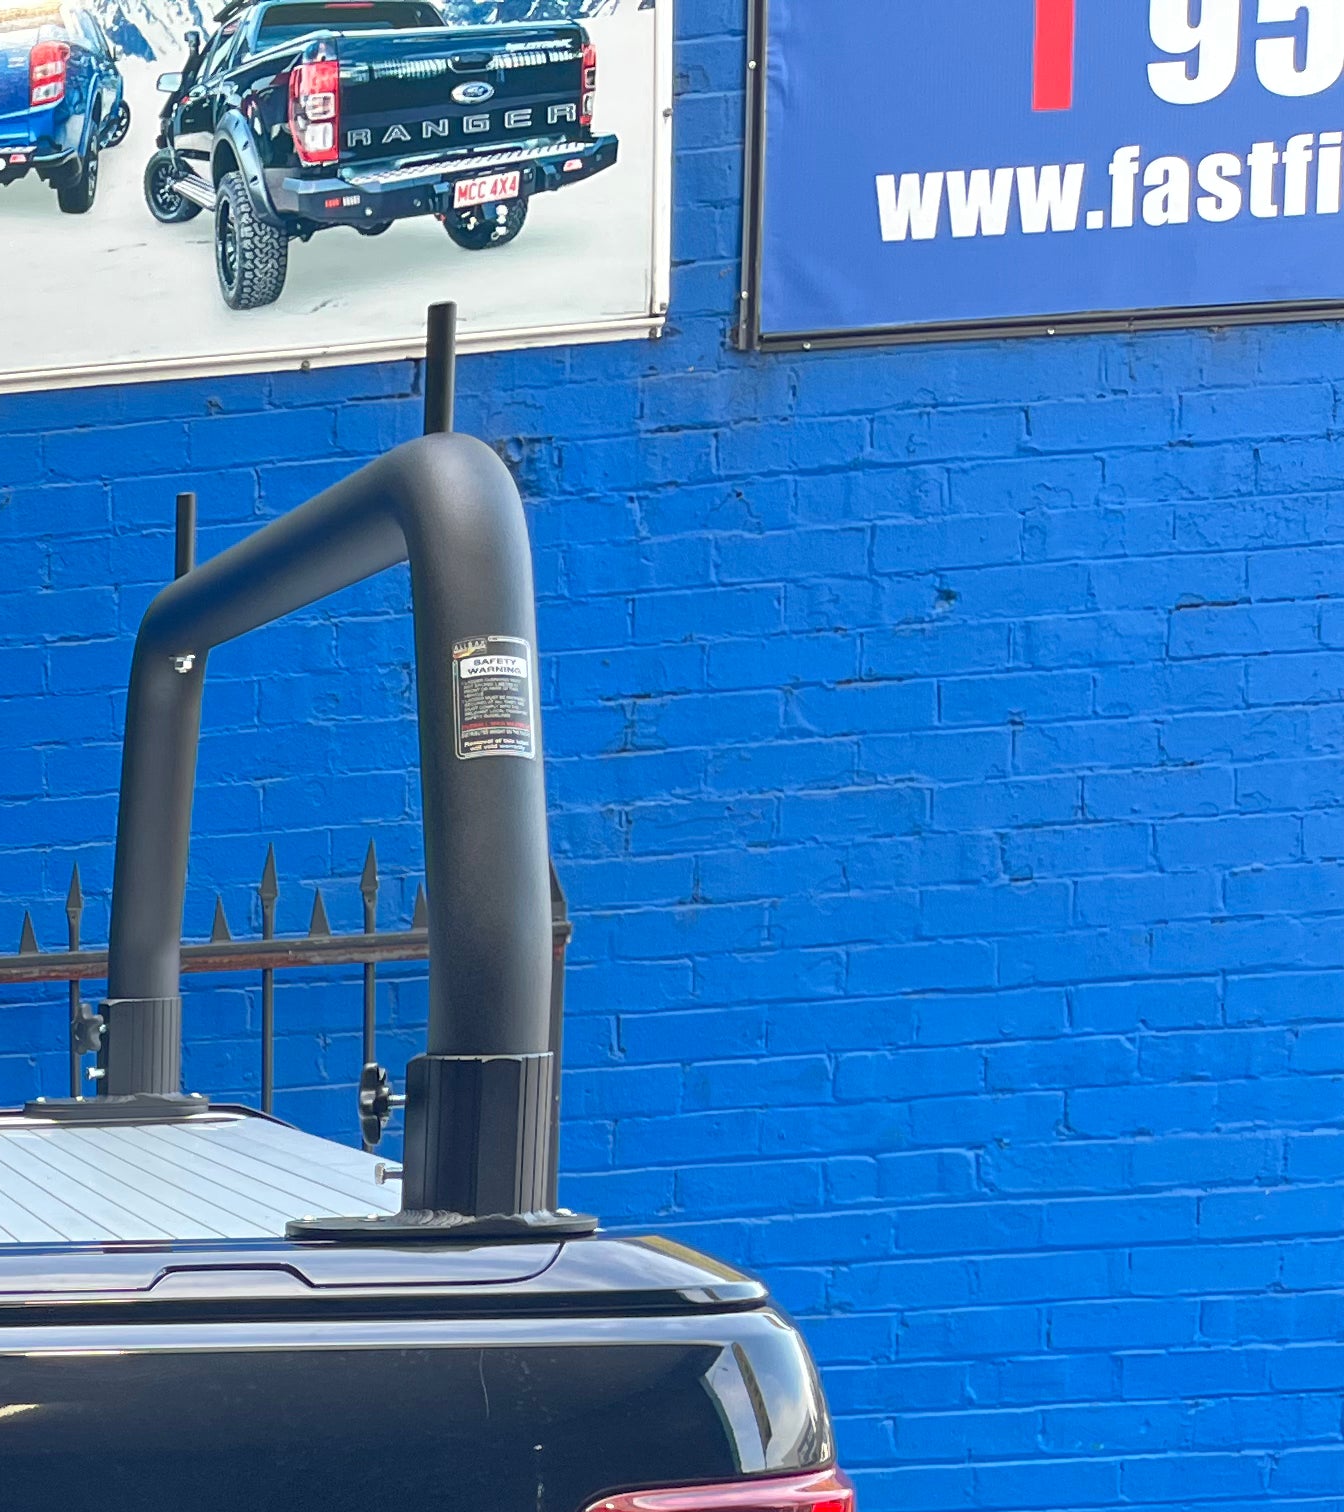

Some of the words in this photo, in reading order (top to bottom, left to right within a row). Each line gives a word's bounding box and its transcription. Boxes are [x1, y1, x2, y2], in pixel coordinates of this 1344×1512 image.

[347, 103, 577, 148] RANGER
[457, 181, 486, 202] MCC
[489, 175, 518, 197] 4X4
[467, 666, 522, 675] WARNING
[473, 657, 517, 667] SAFETY
